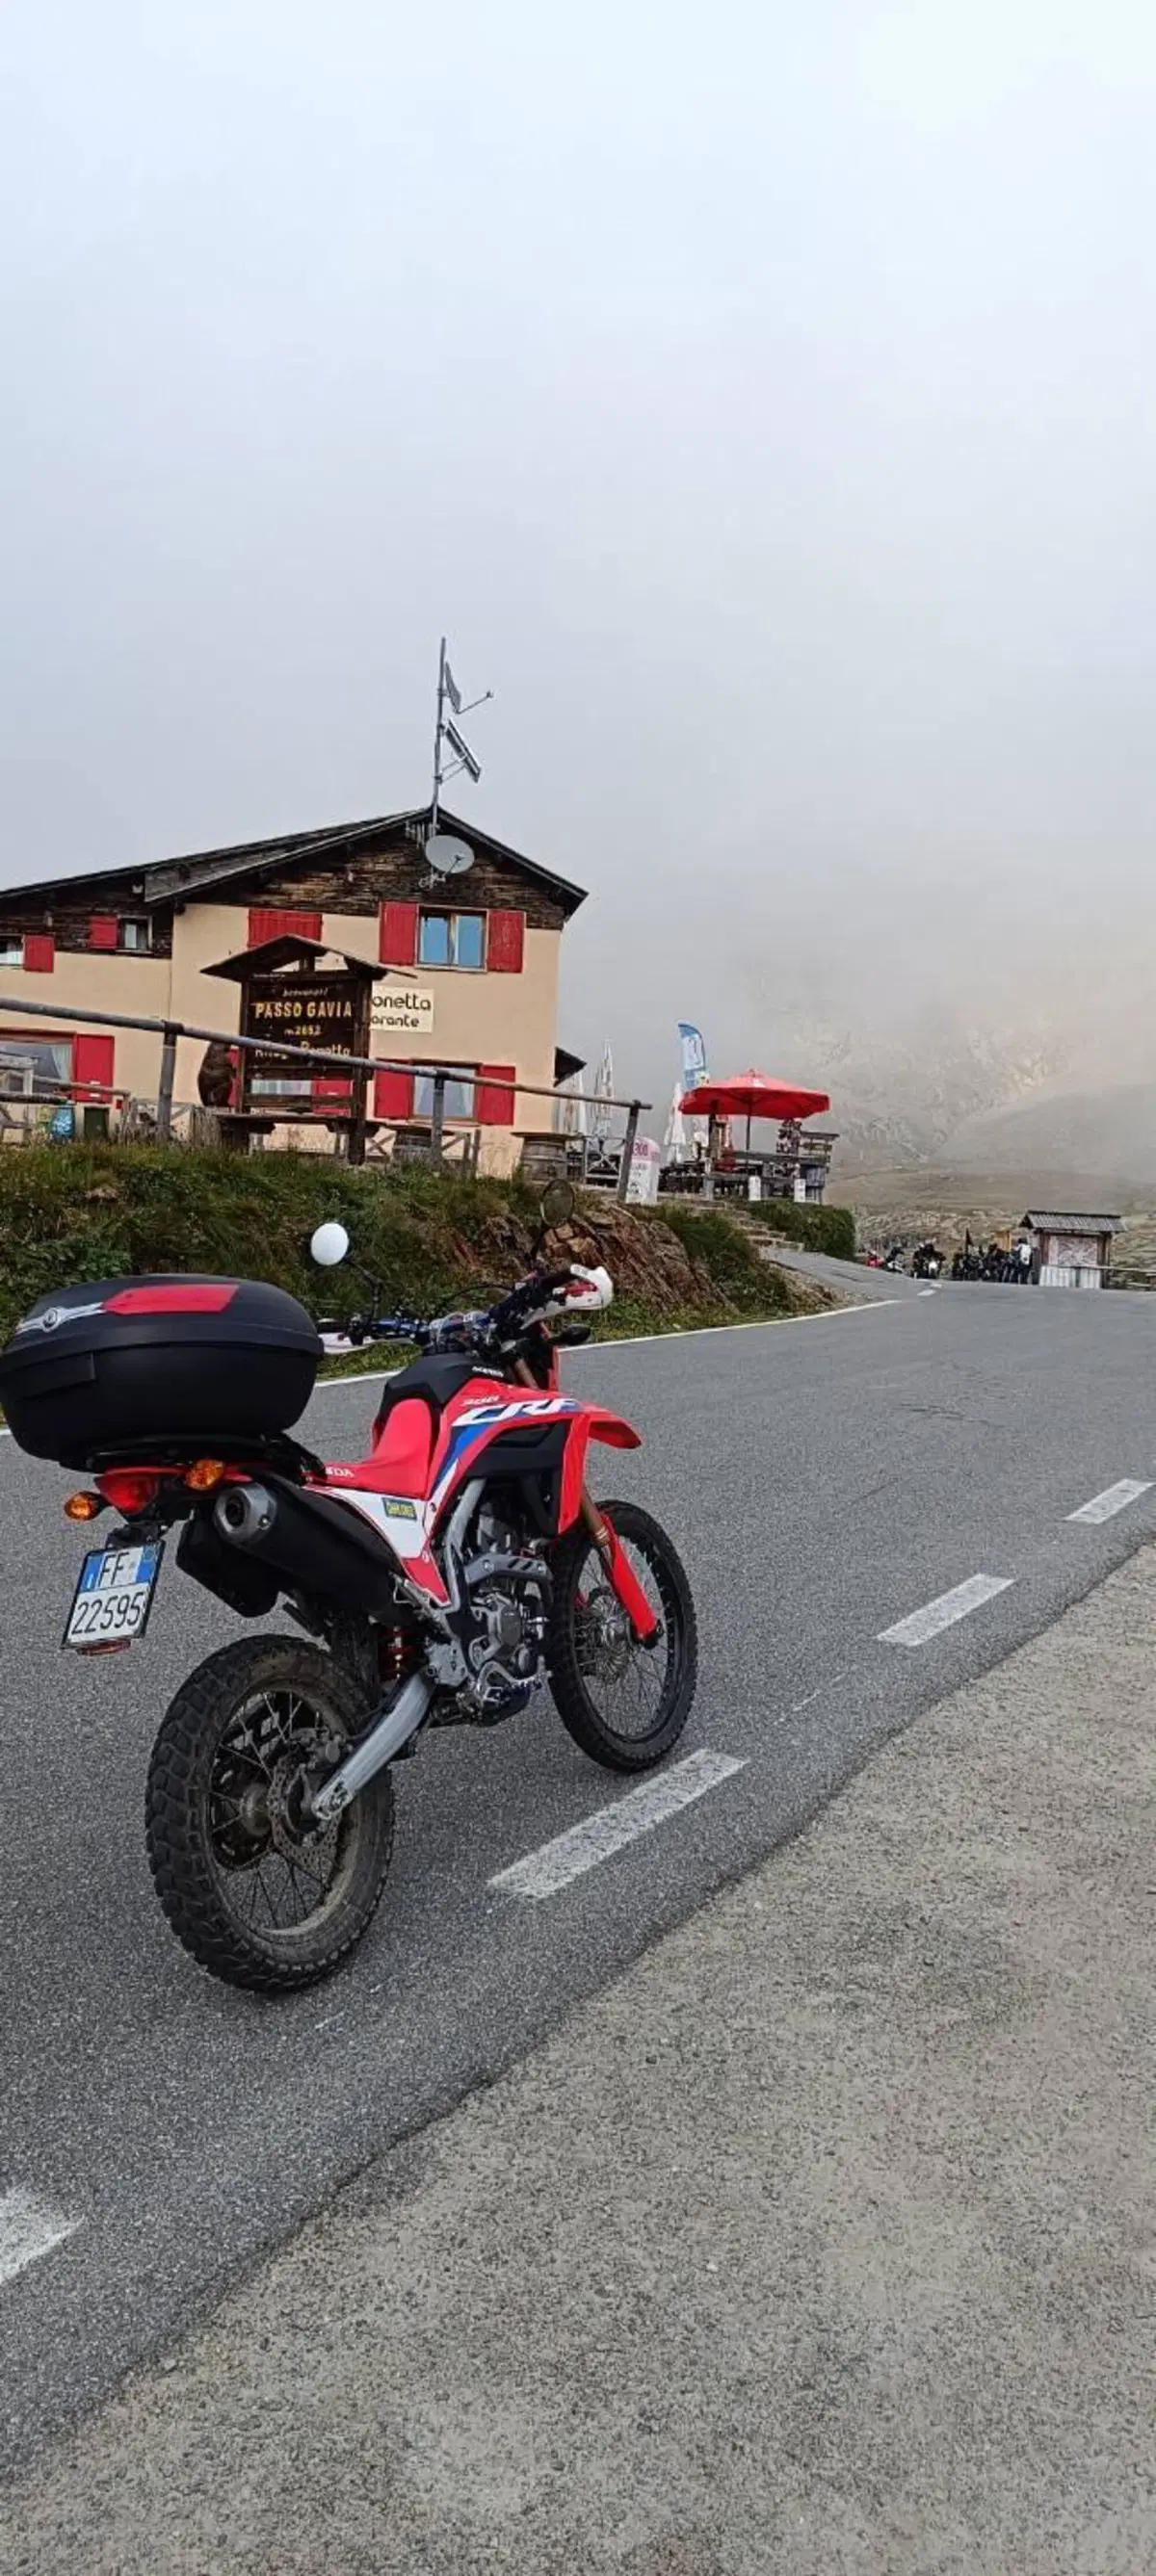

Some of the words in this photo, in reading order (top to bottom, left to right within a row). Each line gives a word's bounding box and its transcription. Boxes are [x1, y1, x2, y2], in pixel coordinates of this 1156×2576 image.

[254, 1002, 302, 1019] PASSO
[306, 1002, 352, 1018] GAVIA
[371, 992, 432, 1011] onetta
[371, 1014, 420, 1028] orante
[453, 1398, 580, 1426] CRF
[324, 1466, 355, 1478] NDA
[97, 1551, 130, 1588] FF
[71, 1592, 144, 1635] 22595
